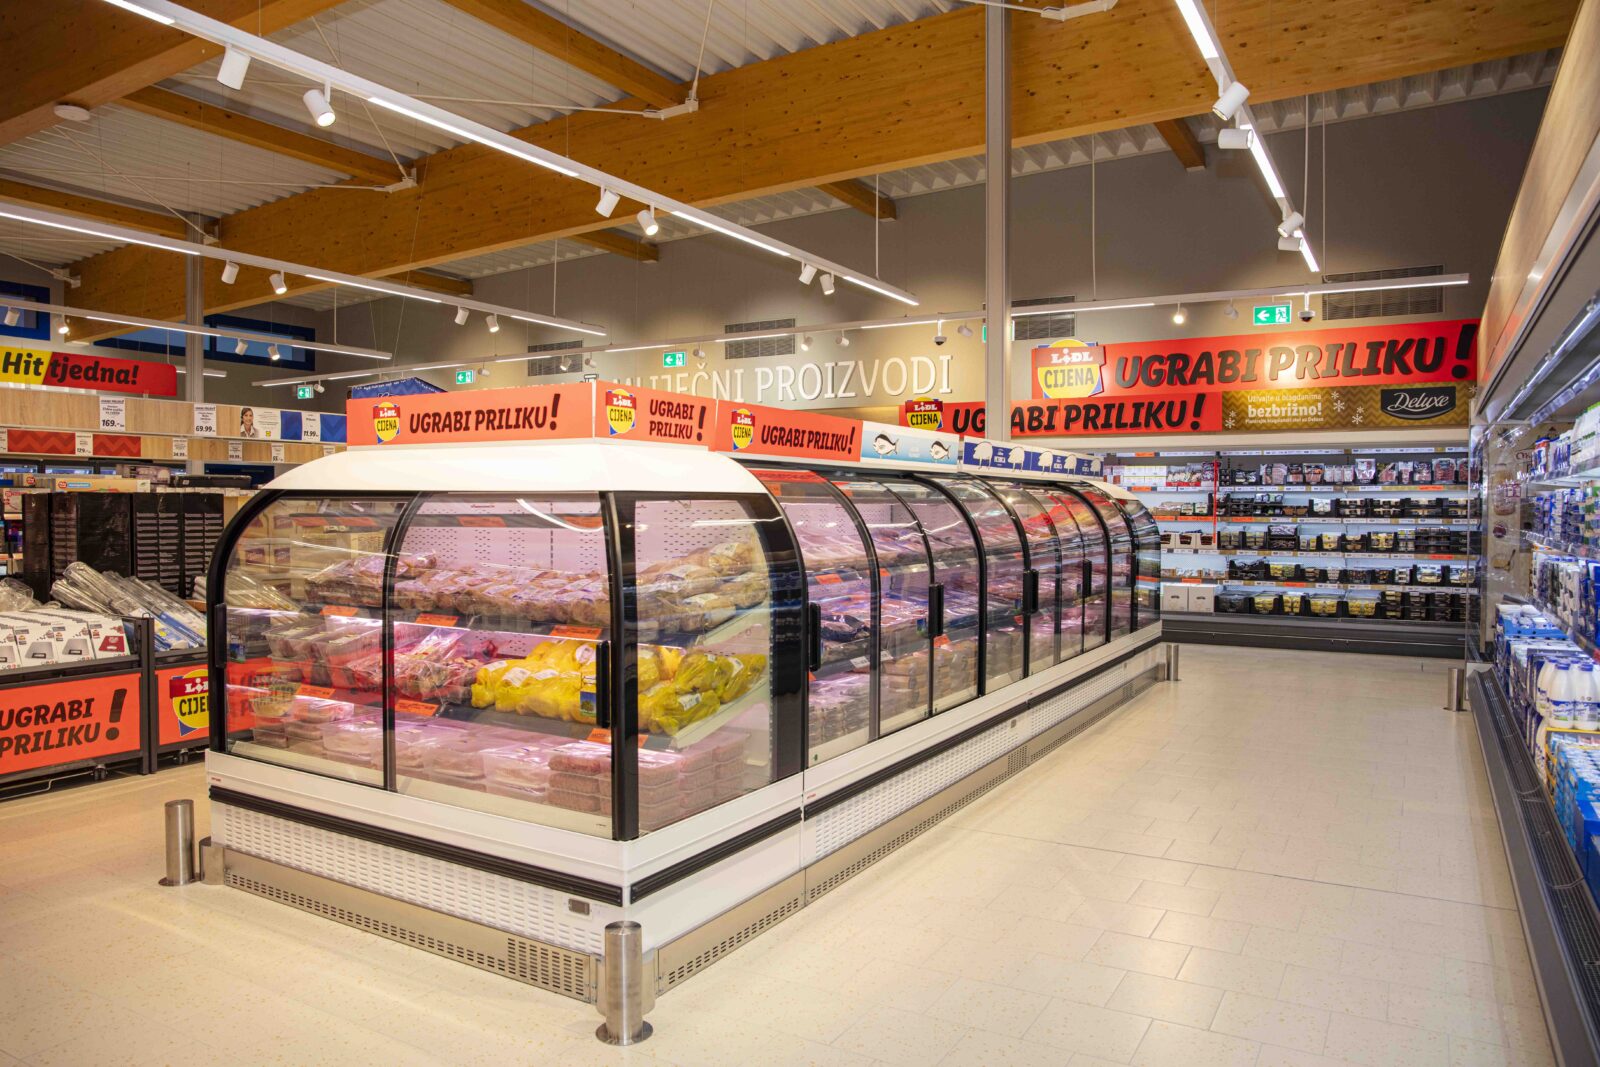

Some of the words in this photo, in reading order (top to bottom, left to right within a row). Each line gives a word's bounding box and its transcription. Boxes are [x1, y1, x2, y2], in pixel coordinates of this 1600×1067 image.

[1115, 349, 1262, 387] UGRABI
[1269, 323, 1478, 381] PRILIKU!
[2, 352, 44, 376] Hit
[50, 356, 140, 385] tjedna!
[754, 355, 954, 403] PROIZVODI
[1044, 367, 1095, 390] CIJENA
[409, 410, 471, 435] UGRABI
[475, 392, 561, 431] PRILIKU!
[650, 399, 694, 420] UGRABI
[952, 405, 1058, 433] UGABI
[1064, 393, 1207, 432] PRILIKU!
[1247, 402, 1322, 418] bezbrižno!
[1387, 391, 1449, 413] Deluxe
[376, 420, 398, 432] CIJENA
[609, 408, 633, 423] CIJENA
[909, 412, 939, 426] CIJENA
[733, 425, 753, 441] CIJENA
[761, 424, 806, 447] UGRABI
[808, 426, 856, 455] PRILIKU!
[0, 697, 95, 731] UGRABI
